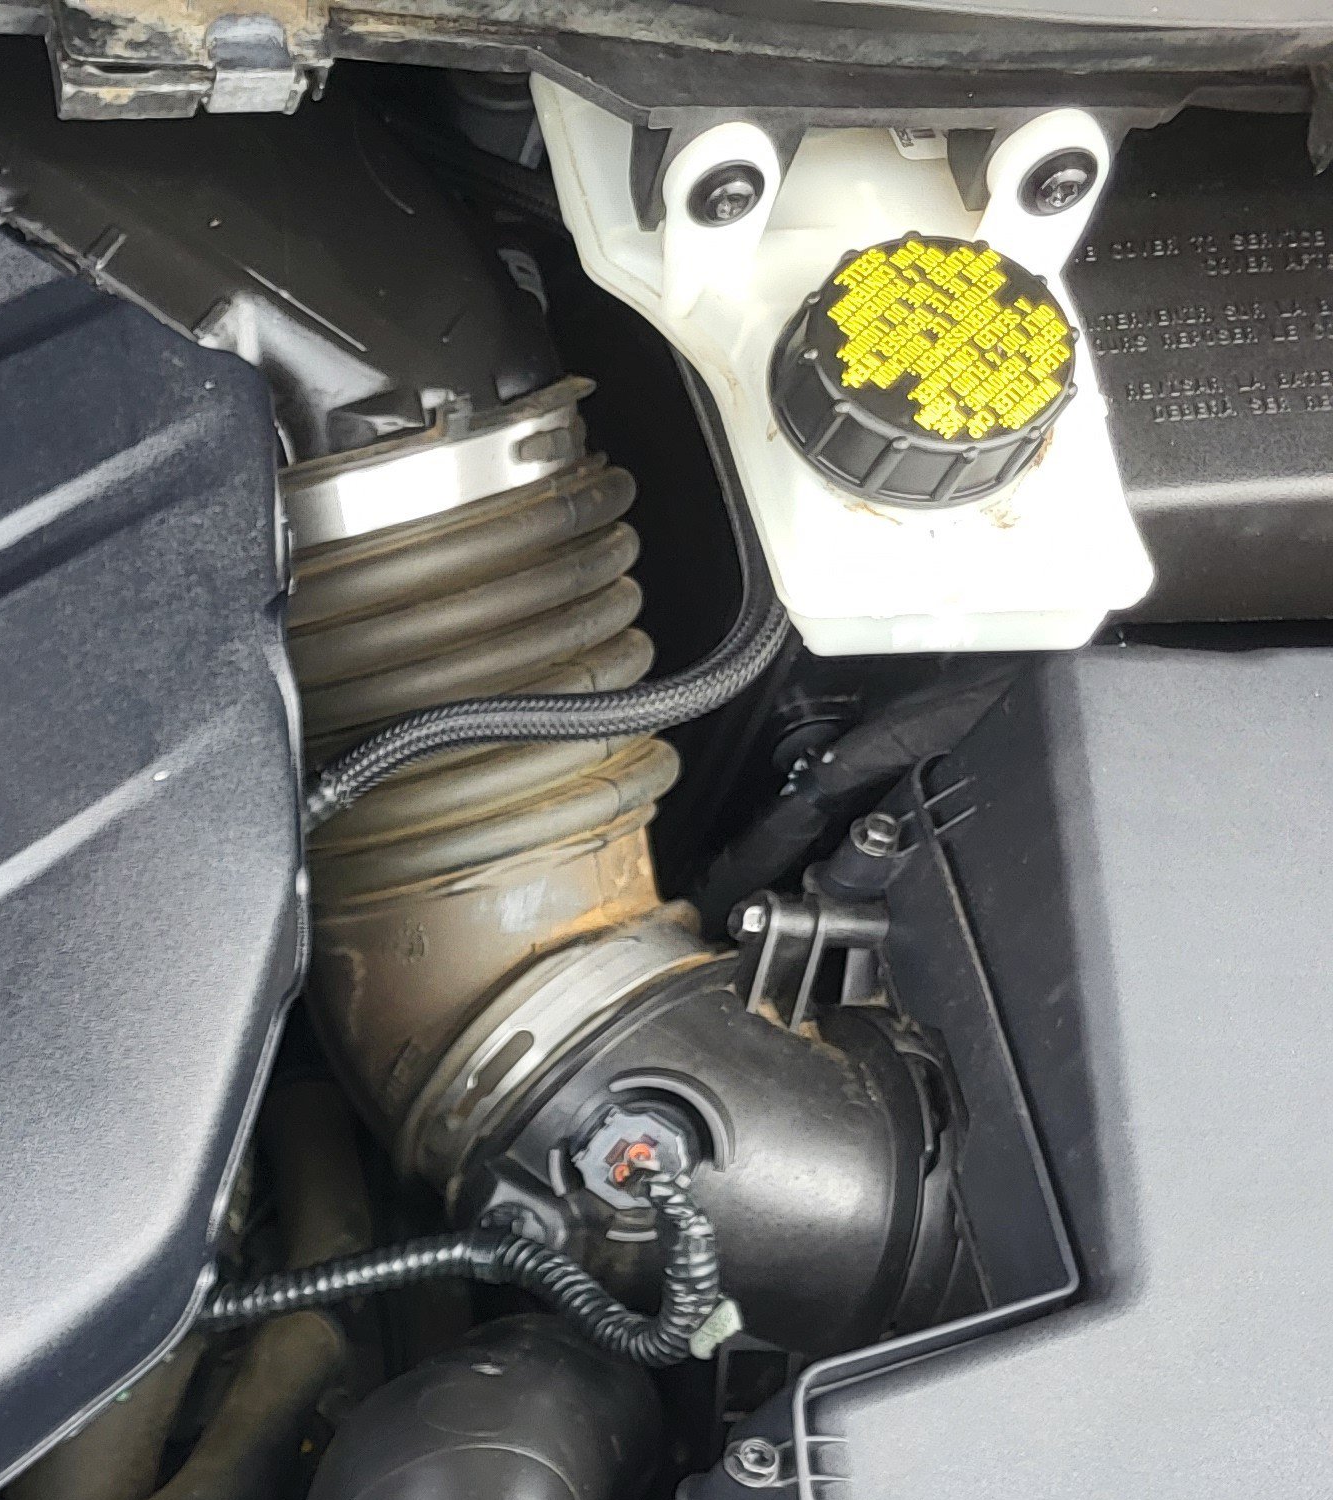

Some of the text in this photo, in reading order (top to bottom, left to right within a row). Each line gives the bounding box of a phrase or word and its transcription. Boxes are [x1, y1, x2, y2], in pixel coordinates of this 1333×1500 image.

[915, 247, 945, 273] DOT
[926, 246, 976, 291] PLOYER
[962, 248, 1001, 283] AVANT
[827, 261, 898, 325] CONTENANT
[840, 274, 911, 341] PROVENANT
[902, 279, 934, 311] QUE
[944, 267, 1007, 325] NETTOYER
[907, 296, 1002, 379] AVERTISSEMENT:
[974, 307, 1021, 350] SEALED
[997, 329, 1025, 356] DOT
[1020, 317, 1069, 362] BEFORE
[1021, 304, 1057, 336] ONLY
[907, 340, 981, 407] CONTAINER.
[951, 358, 991, 399] FLUID
[959, 352, 1027, 416] REMOVING.
[965, 341, 1070, 438] CLEAN FILLER CAP
[998, 374, 1062, 428] WARNING:
